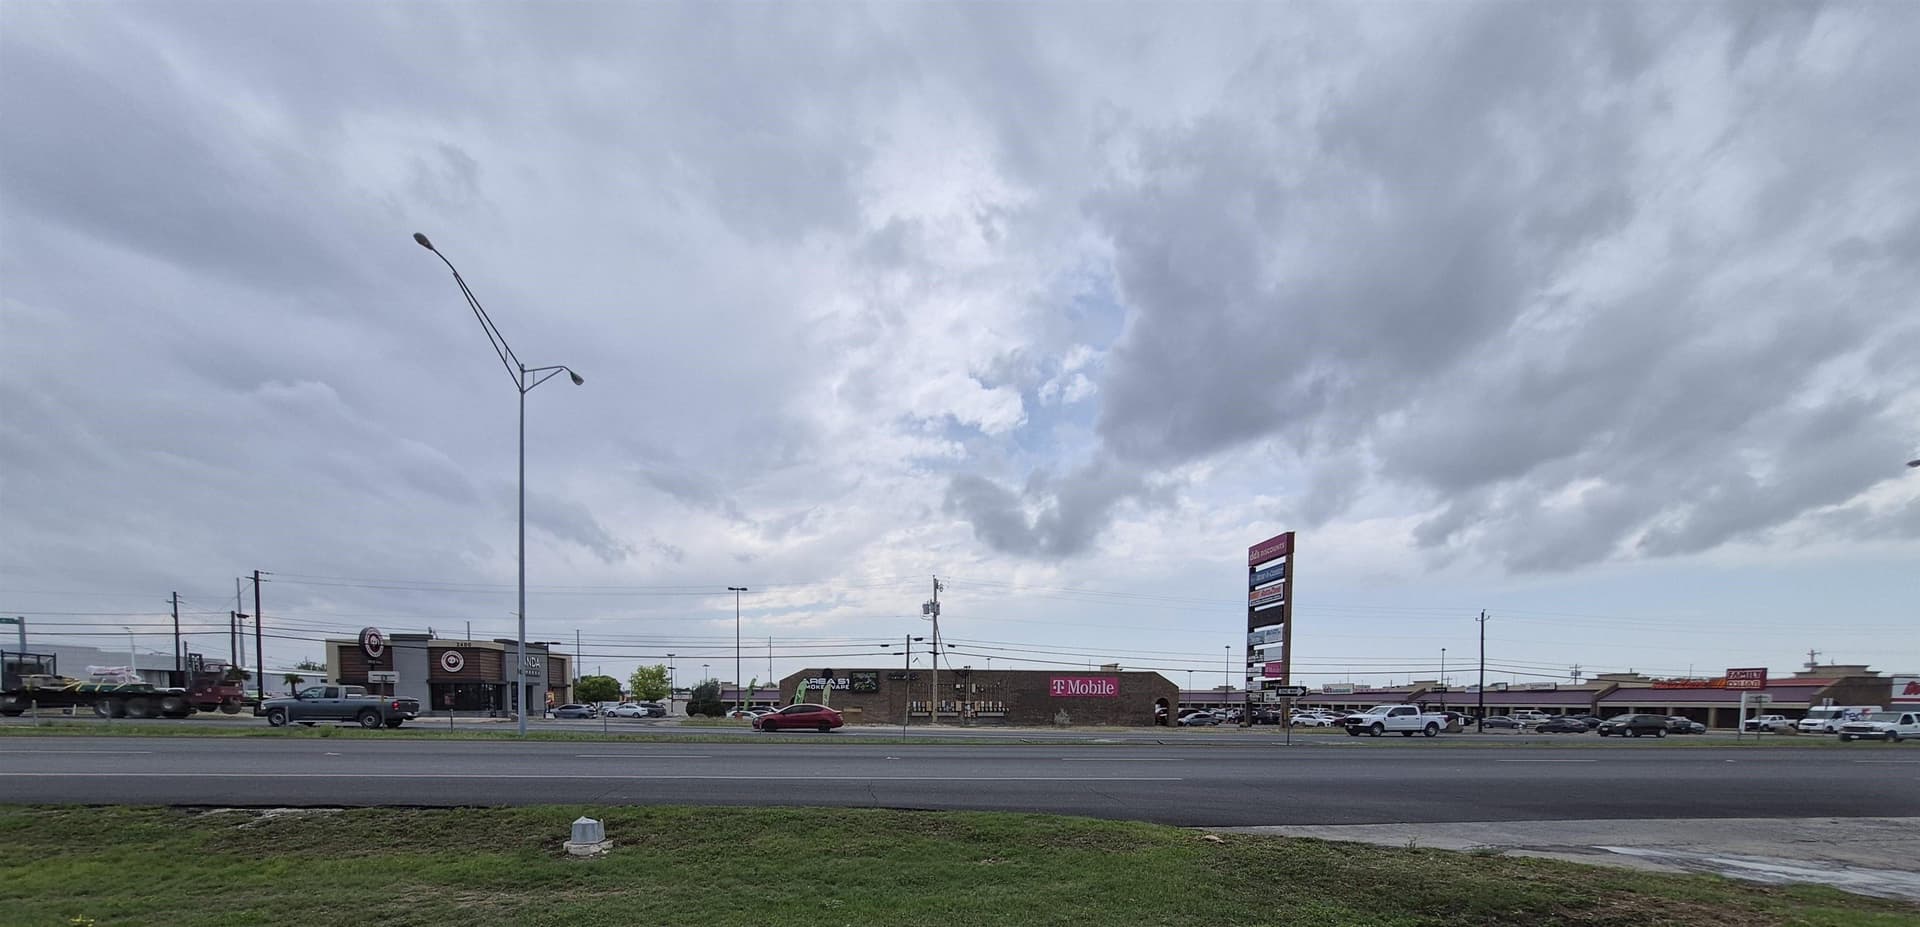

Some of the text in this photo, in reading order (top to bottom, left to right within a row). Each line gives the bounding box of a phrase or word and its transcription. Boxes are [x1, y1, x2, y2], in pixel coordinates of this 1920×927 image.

[1727, 670, 1761, 680] FAMILY
[1067, 680, 1115, 695] Mobile
[1726, 680, 1761, 688] DOLLAR
[1843, 708, 1872, 720] FedE
